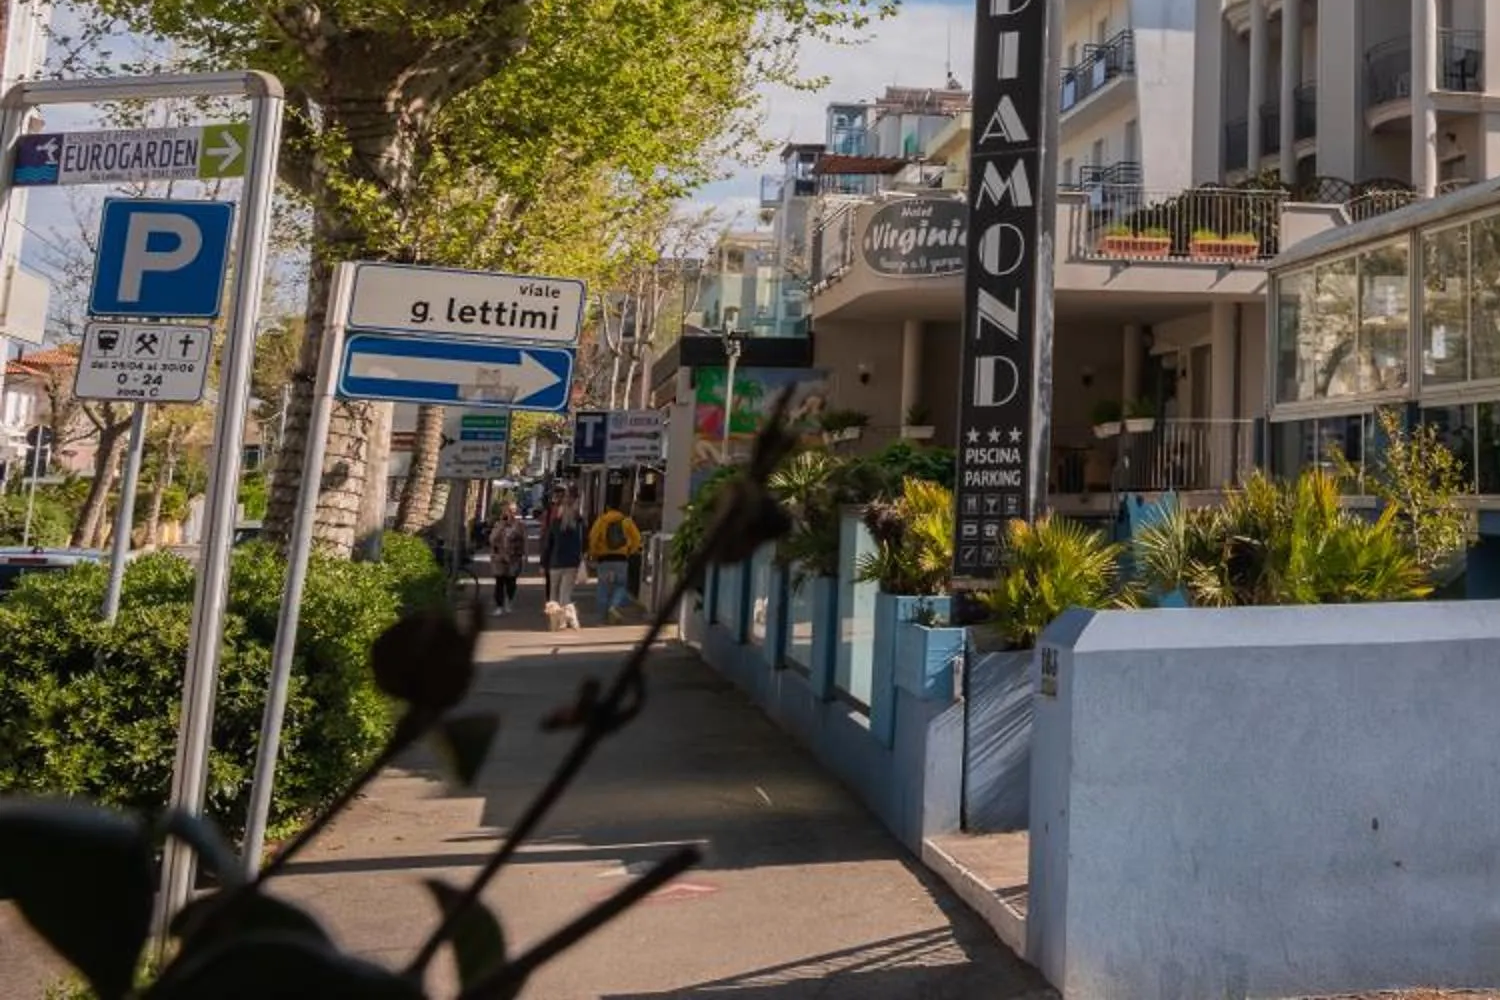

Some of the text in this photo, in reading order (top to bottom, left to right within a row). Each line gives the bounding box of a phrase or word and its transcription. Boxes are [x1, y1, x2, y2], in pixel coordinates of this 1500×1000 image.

[63, 139, 199, 172] EUROGARDEN
[901, 206, 933, 217] Hotel
[116, 211, 203, 303] P
[519, 283, 561, 299] viale
[410, 298, 560, 331] g. lettimi
[143, 373, 163, 386] 24
[116, 387, 159, 397] zona C
[577, 415, 603, 448] T
[965, 448, 1022, 465] PISCINA
[964, 469, 1022, 487] PARKING
